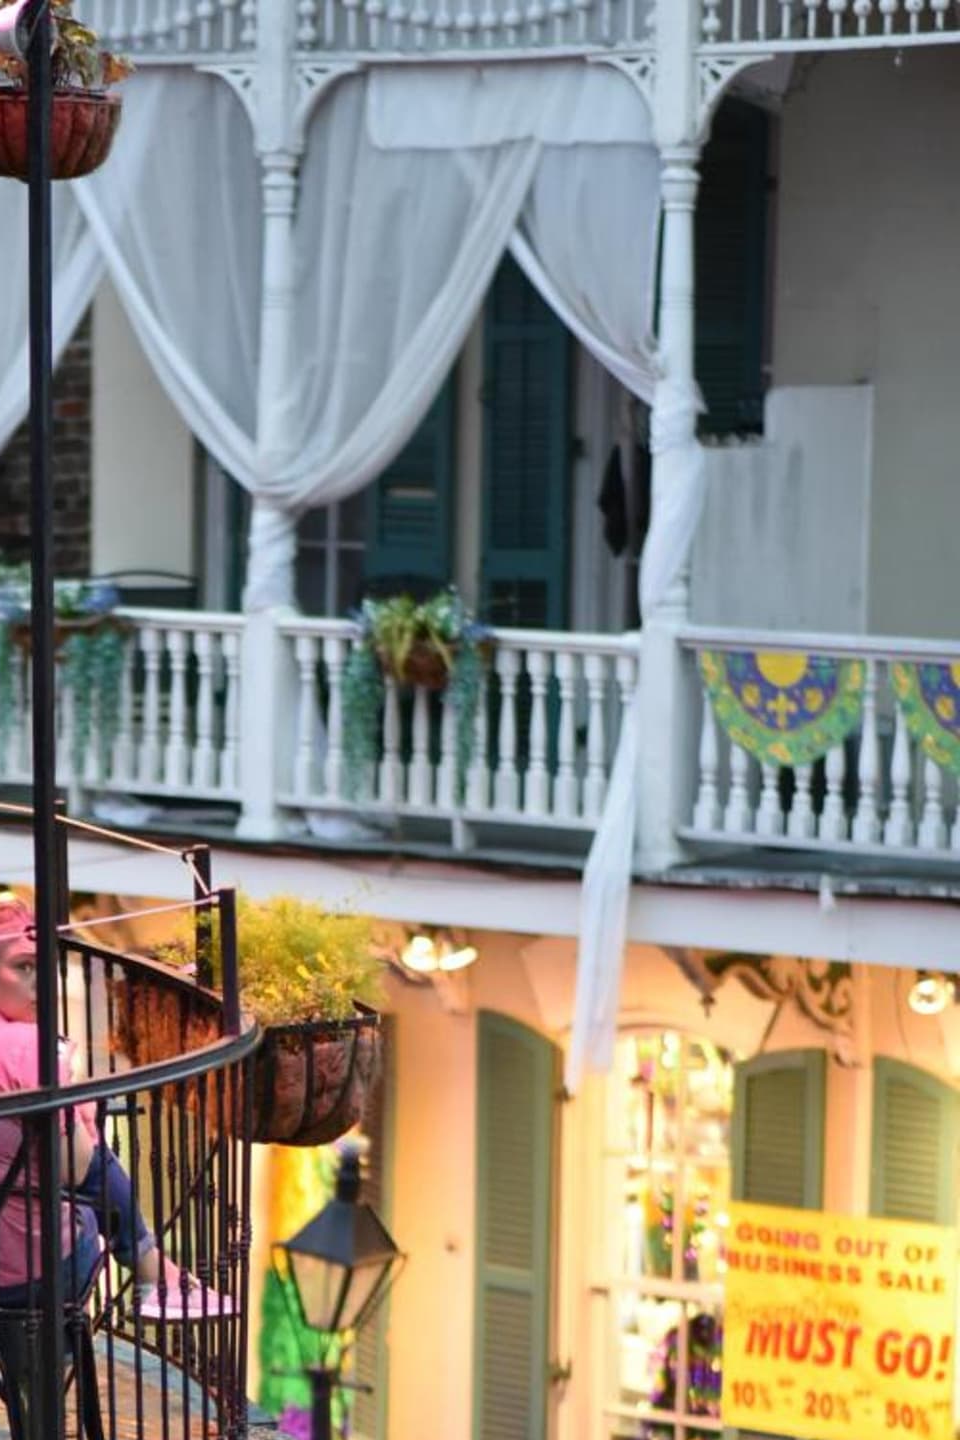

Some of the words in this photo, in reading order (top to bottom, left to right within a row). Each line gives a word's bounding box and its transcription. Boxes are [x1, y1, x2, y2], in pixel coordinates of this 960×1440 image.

[735, 1222, 821, 1252] GOING
[835, 1236, 889, 1259] OUT
[904, 1245, 939, 1264] OF
[725, 1248, 863, 1286] BUSINESS
[878, 1270, 946, 1294] SALE
[744, 1319, 862, 1370] MUST
[874, 1329, 953, 1382] GO!
